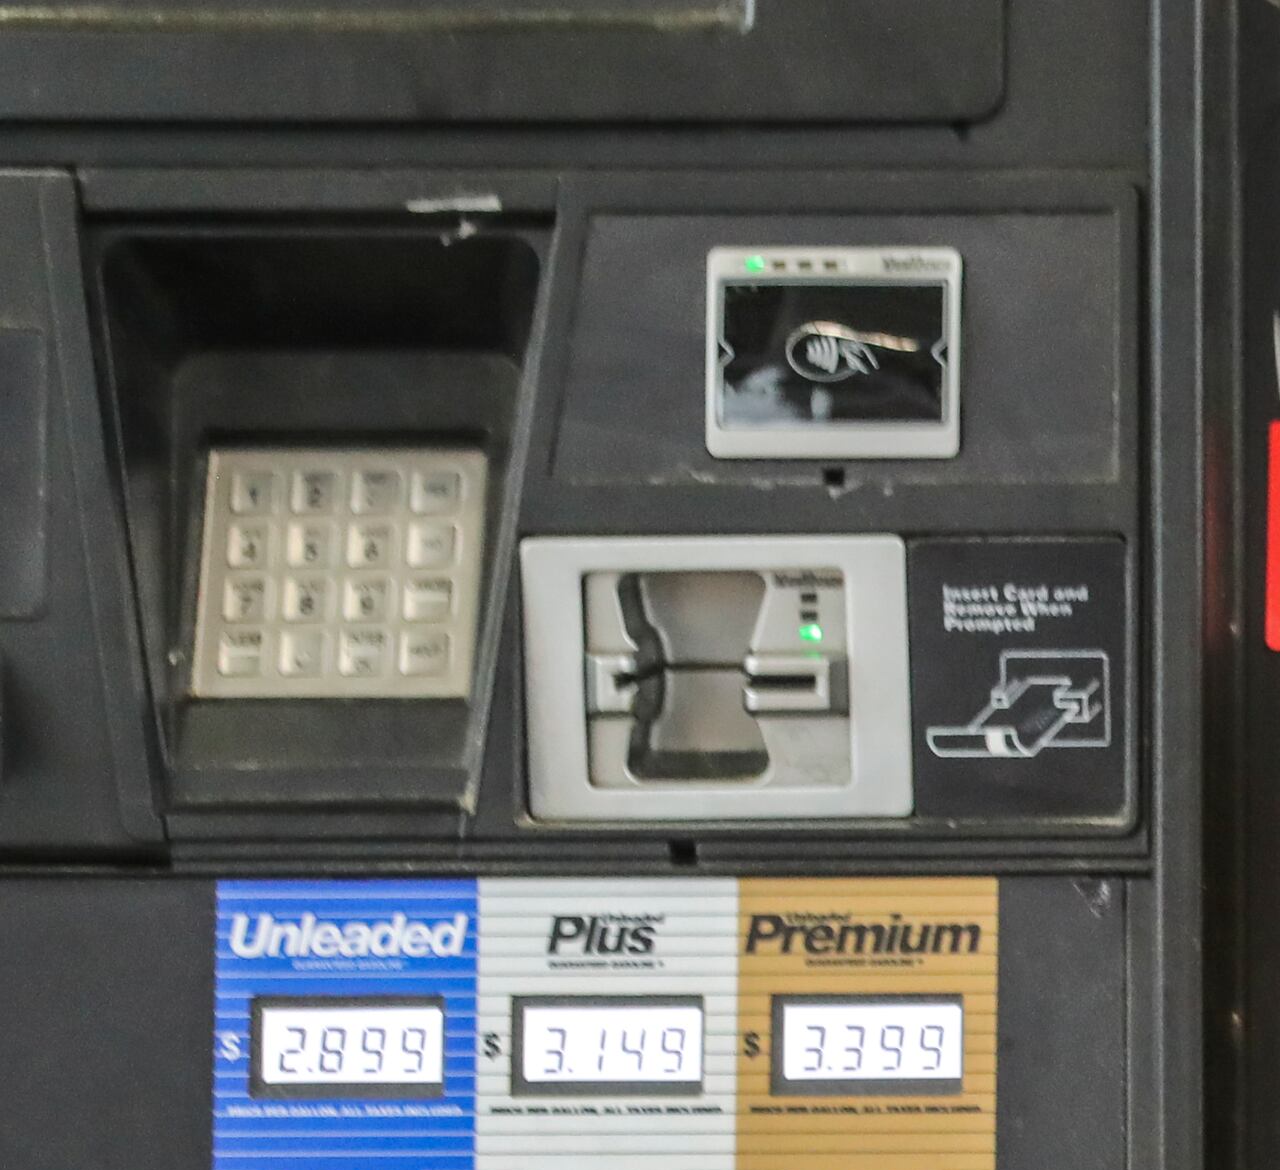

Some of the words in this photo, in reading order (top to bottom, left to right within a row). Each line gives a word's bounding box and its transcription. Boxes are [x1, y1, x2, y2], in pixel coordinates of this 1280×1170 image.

[942, 582, 999, 602] Insert
[1003, 582, 1049, 602] Card
[1052, 583, 1089, 602] and
[943, 601, 1018, 618] Remove
[1019, 600, 1073, 617] When
[943, 616, 1036, 635] Prompted
[229, 911, 470, 959] Unleaded
[546, 914, 657, 955] Plus
[745, 912, 981, 955] Premium
[279, 1026, 427, 1074] 2.899
[483, 1030, 501, 1062] $
[544, 1026, 687, 1074] 3.149
[743, 1030, 762, 1060] $
[803, 1024, 945, 1072] 3.399
